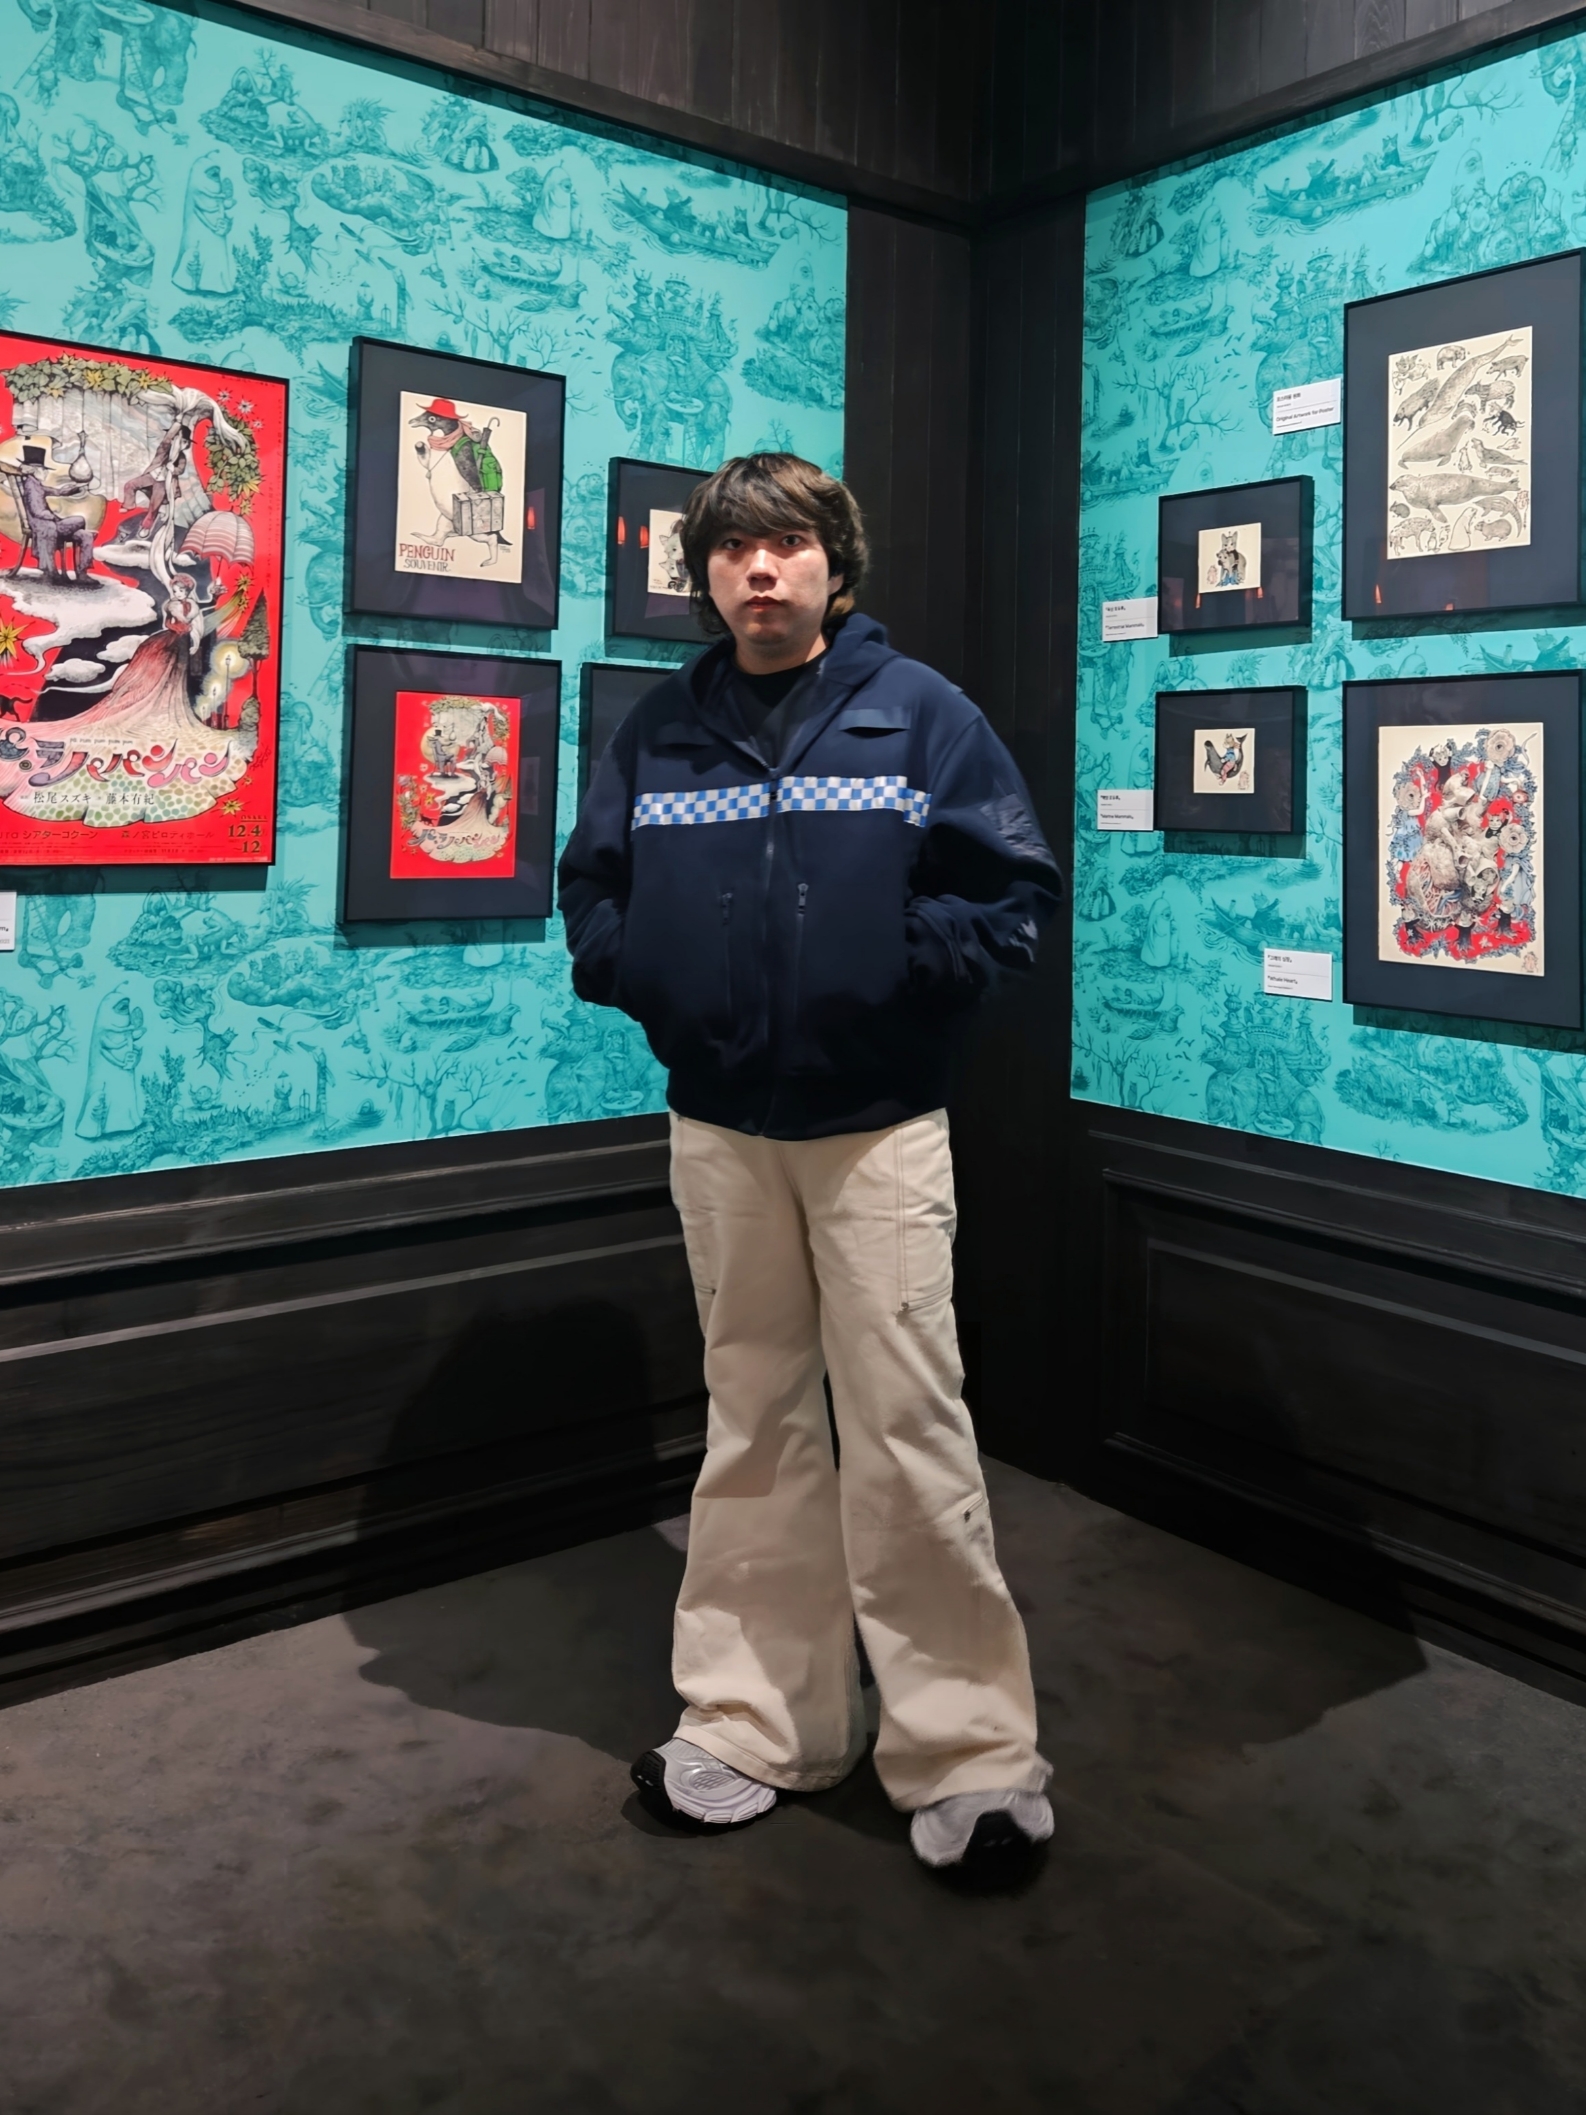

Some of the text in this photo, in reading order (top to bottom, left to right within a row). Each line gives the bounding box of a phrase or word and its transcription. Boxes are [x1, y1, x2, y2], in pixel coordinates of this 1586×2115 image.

[399, 543, 456, 561] PENGUIN
[34, 792, 92, 804] 松尾スズキ
[106, 793, 154, 806] 藤本有紀
[22, 830, 98, 840] シアターコクーン
